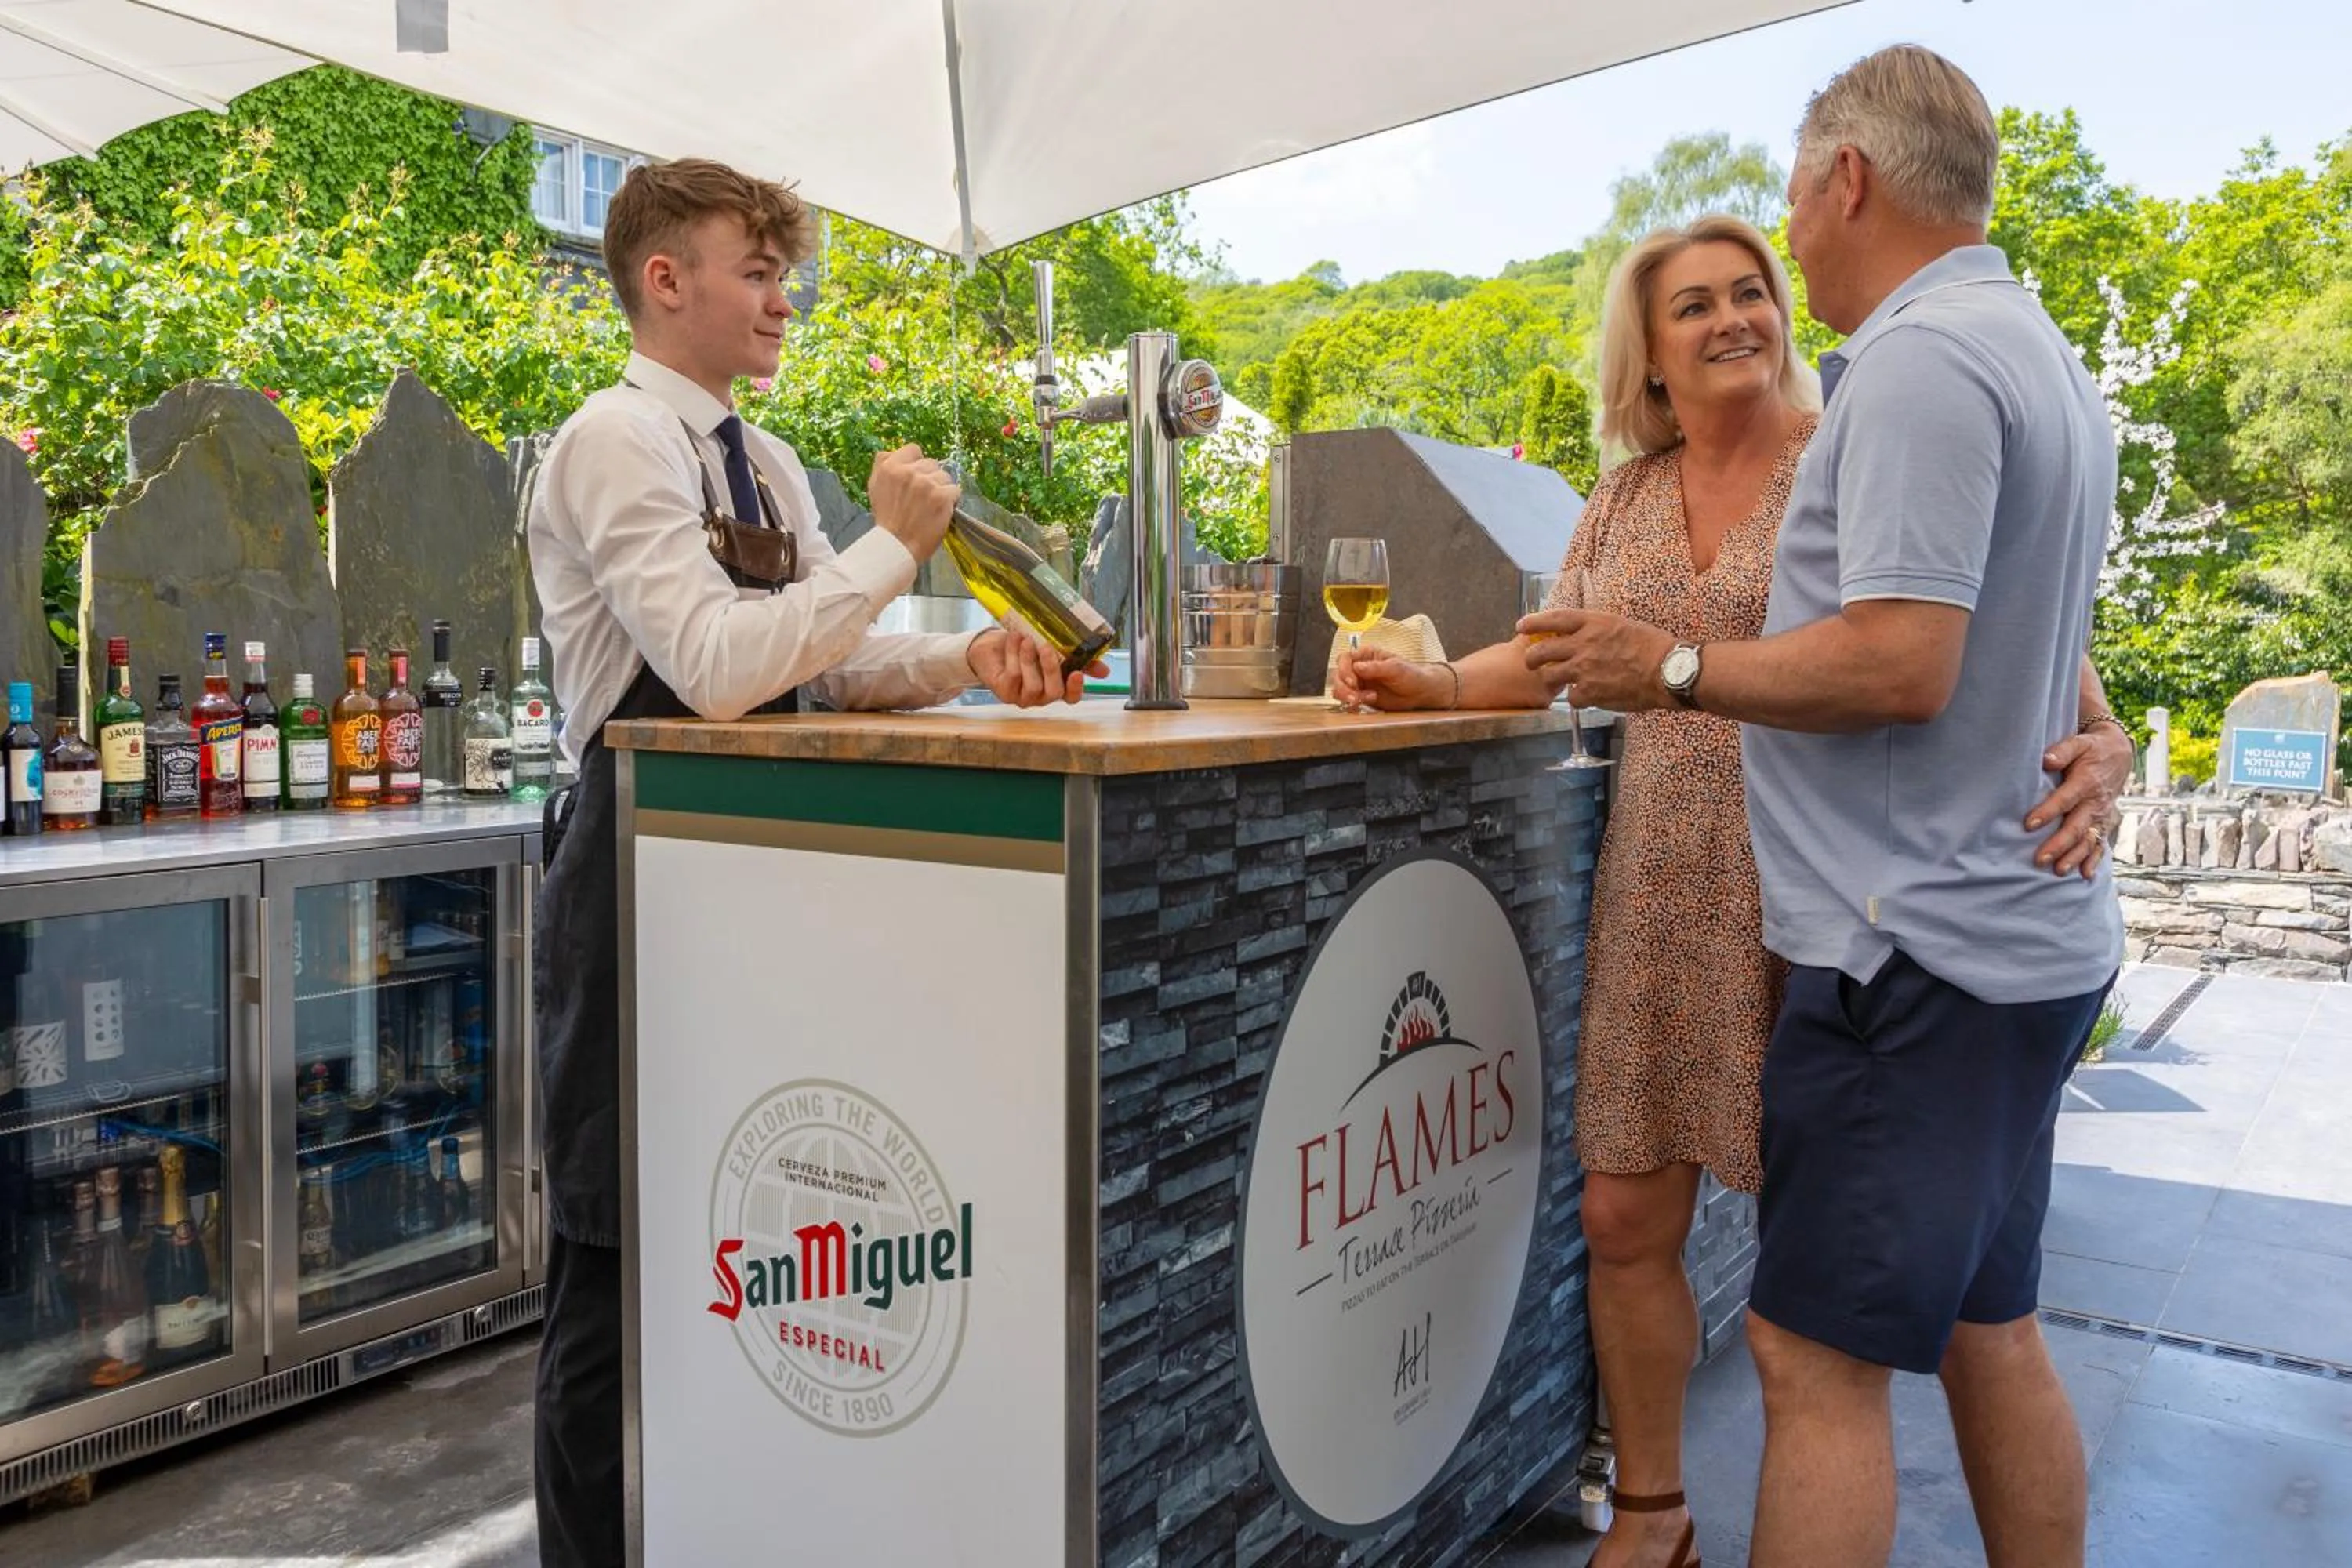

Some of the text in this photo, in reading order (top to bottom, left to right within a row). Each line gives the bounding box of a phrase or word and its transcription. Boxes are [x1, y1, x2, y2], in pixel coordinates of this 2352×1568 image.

[247, 738, 277, 751] PIMM
[2245, 748, 2313, 760] NO GLASS OR
[2244, 757, 2313, 771] BOTTLES PAST
[2246, 767, 2307, 779] THIS POINT
[729, 1093, 946, 1225] EXPLORING THE WORLD
[1296, 1049, 1515, 1251] FLAMES
[778, 1156, 887, 1191] CERVEZA PREMIUM
[785, 1171, 879, 1203] INTERNACIONAL
[779, 1320, 886, 1374] ESPECIAL
[771, 1359, 895, 1424] SINCE 1890
